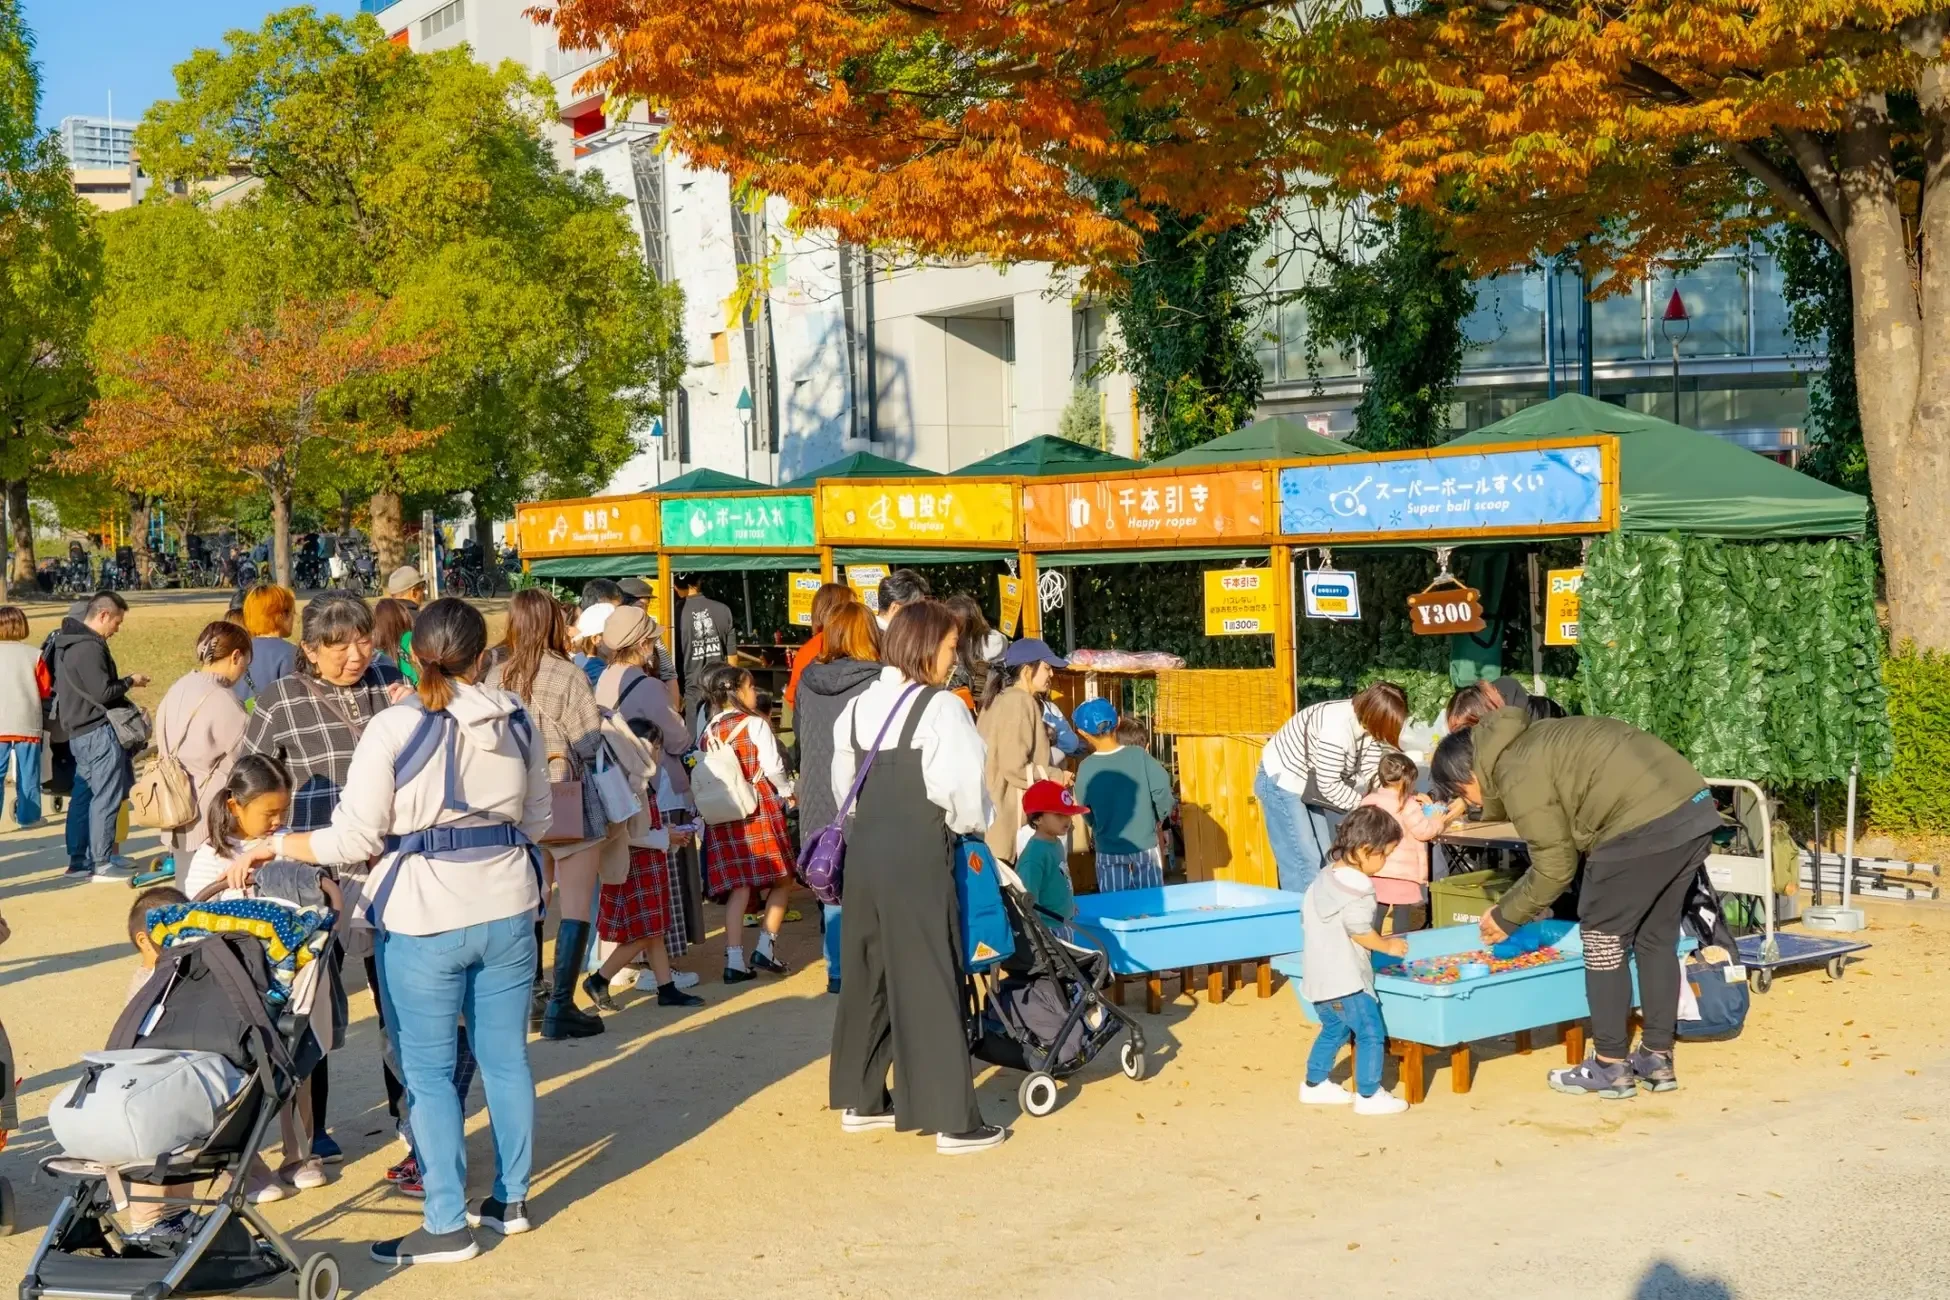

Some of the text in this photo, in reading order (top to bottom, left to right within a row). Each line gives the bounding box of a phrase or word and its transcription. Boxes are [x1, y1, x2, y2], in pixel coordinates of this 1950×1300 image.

[1376, 473, 1544, 500] スーパーボールすくい
[1119, 484, 1209, 516] 千本引き
[1407, 499, 1510, 516] Super ball scoop
[716, 507, 784, 528] ボール入れ
[1127, 516, 1198, 531] Happy ropes
[1223, 577, 1258, 588] 千本引き
[1224, 620, 1258, 630] 1回300円
[693, 643, 721, 656] JAAN
